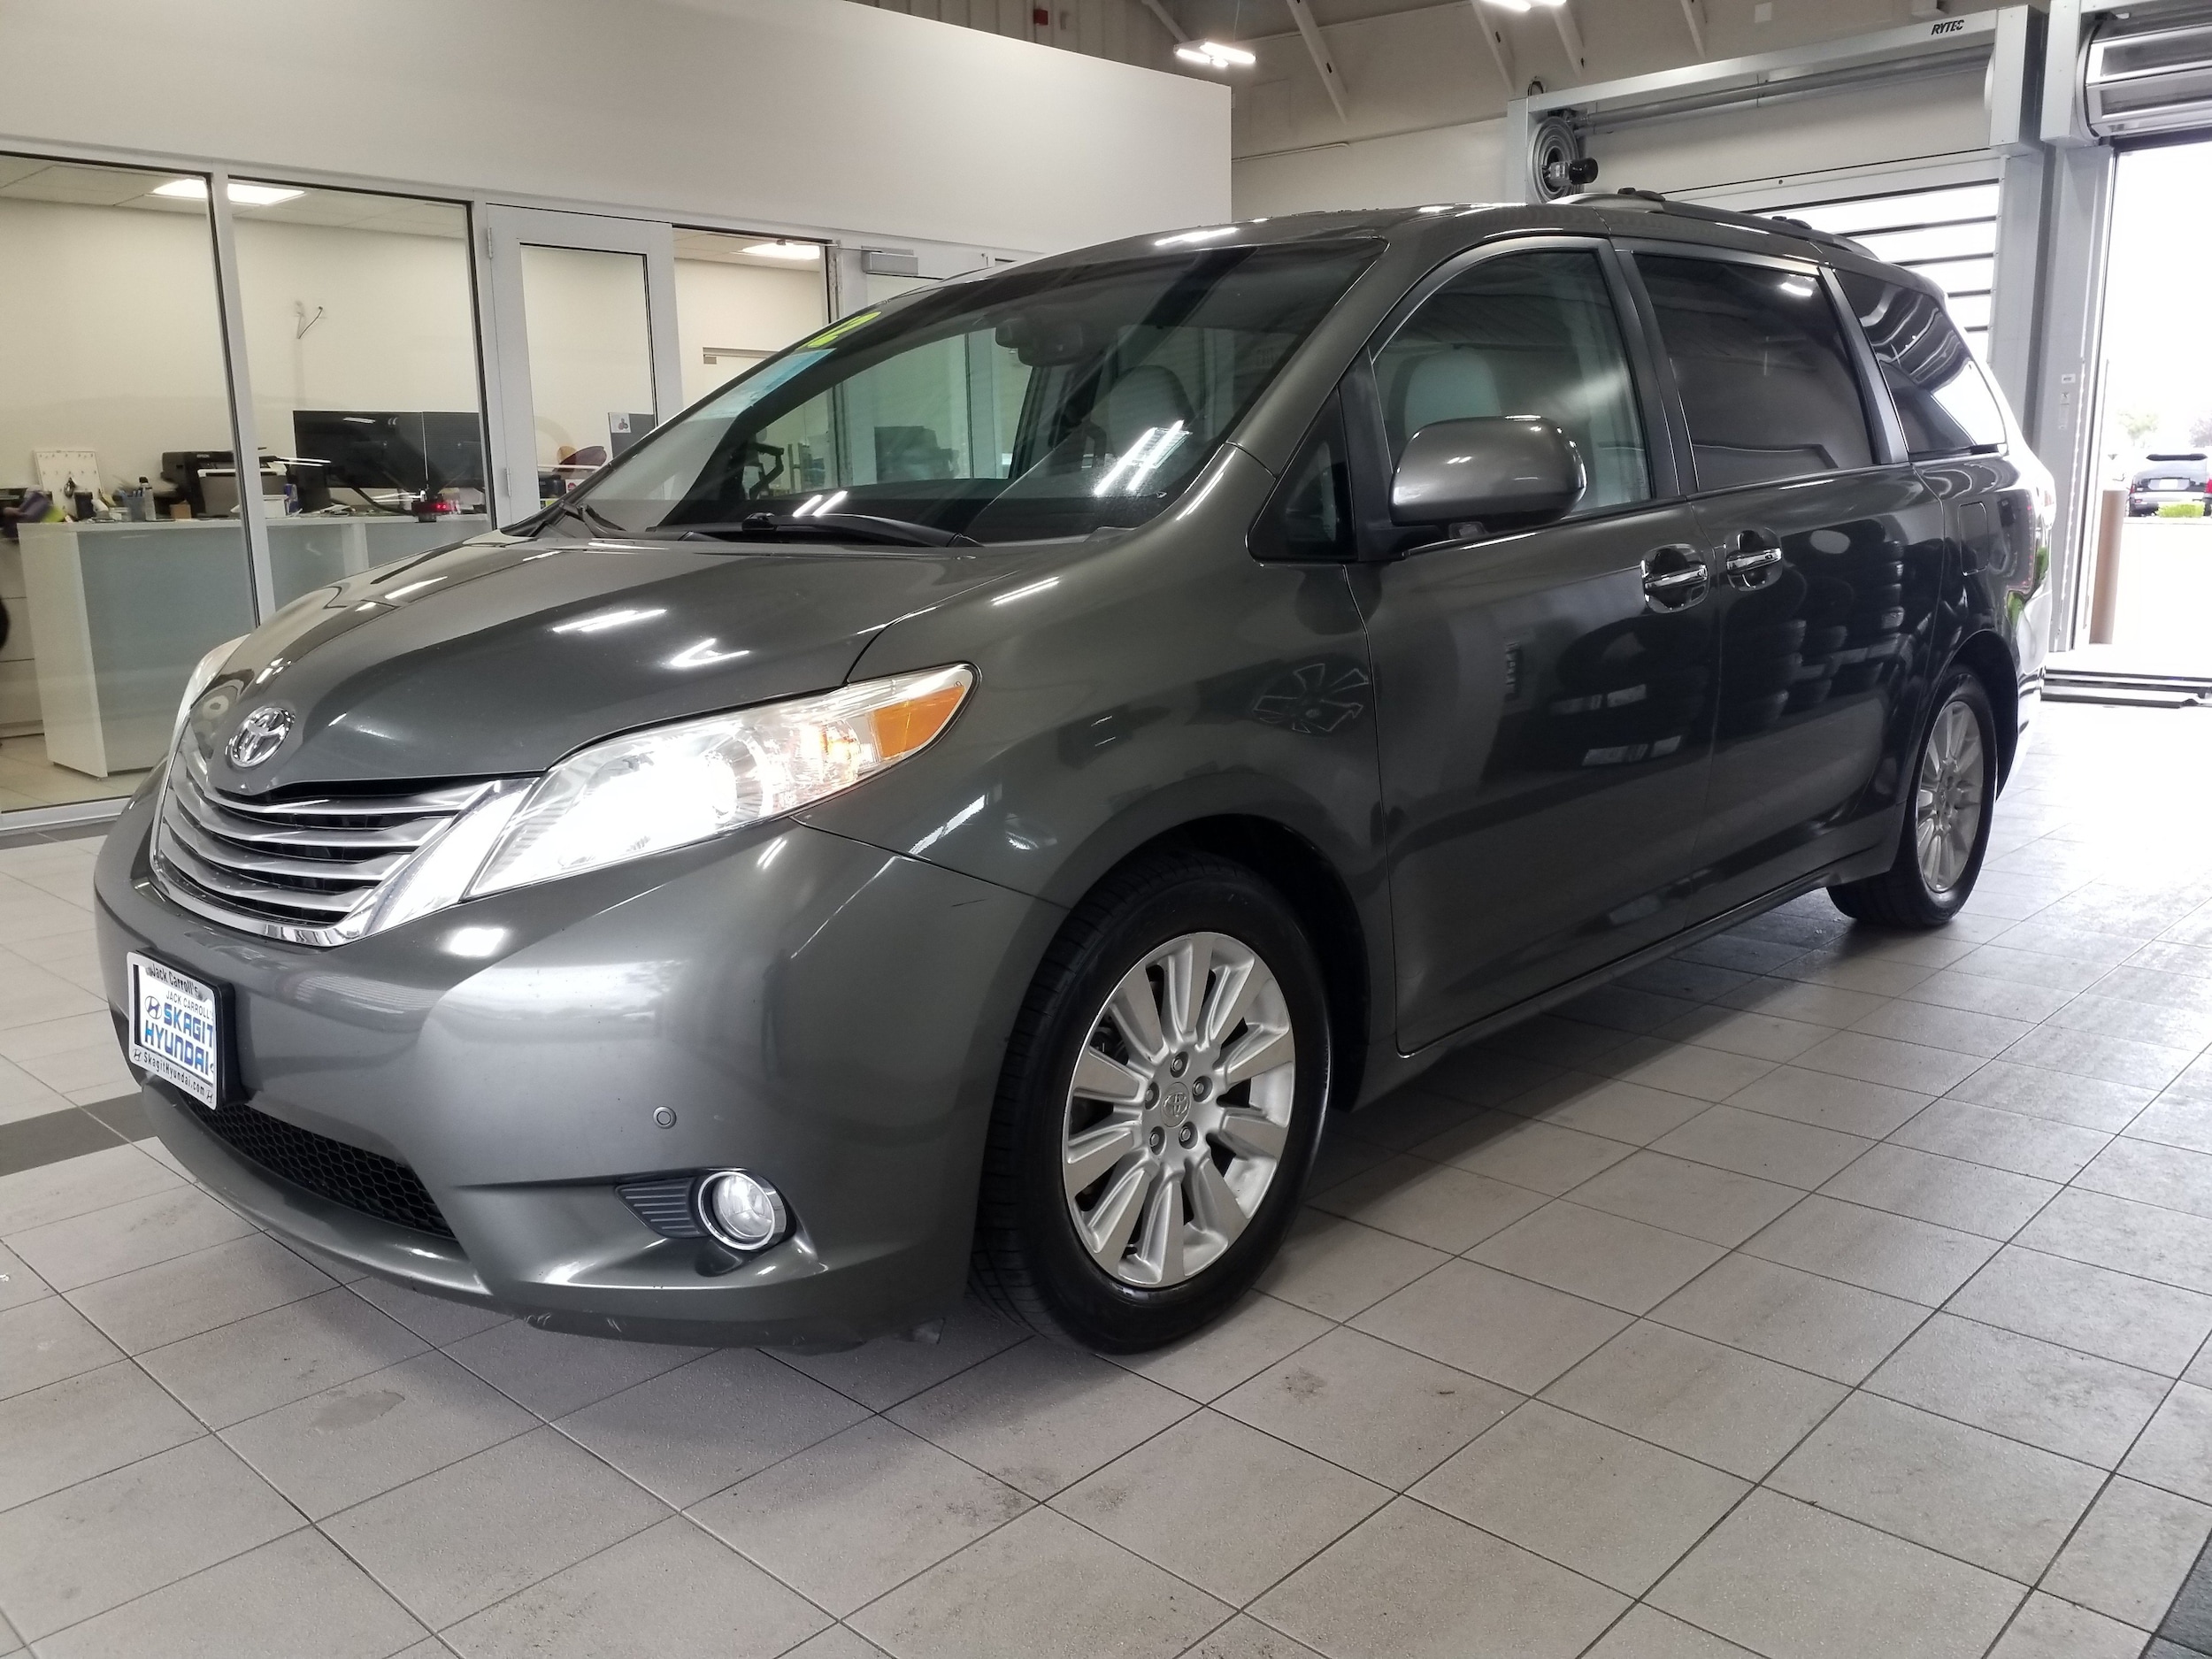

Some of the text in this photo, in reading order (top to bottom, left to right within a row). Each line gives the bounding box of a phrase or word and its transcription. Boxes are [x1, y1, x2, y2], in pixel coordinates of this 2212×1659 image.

[1931, 19, 1965, 35] RYTEC
[150, 964, 199, 998] Jack Carroll's
[165, 990, 182, 1006] JACK
[163, 1002, 213, 1048] SKAGIT
[144, 1019, 209, 1076] HYUNDAI
[143, 1051, 205, 1097] SkagitHyundai.com
